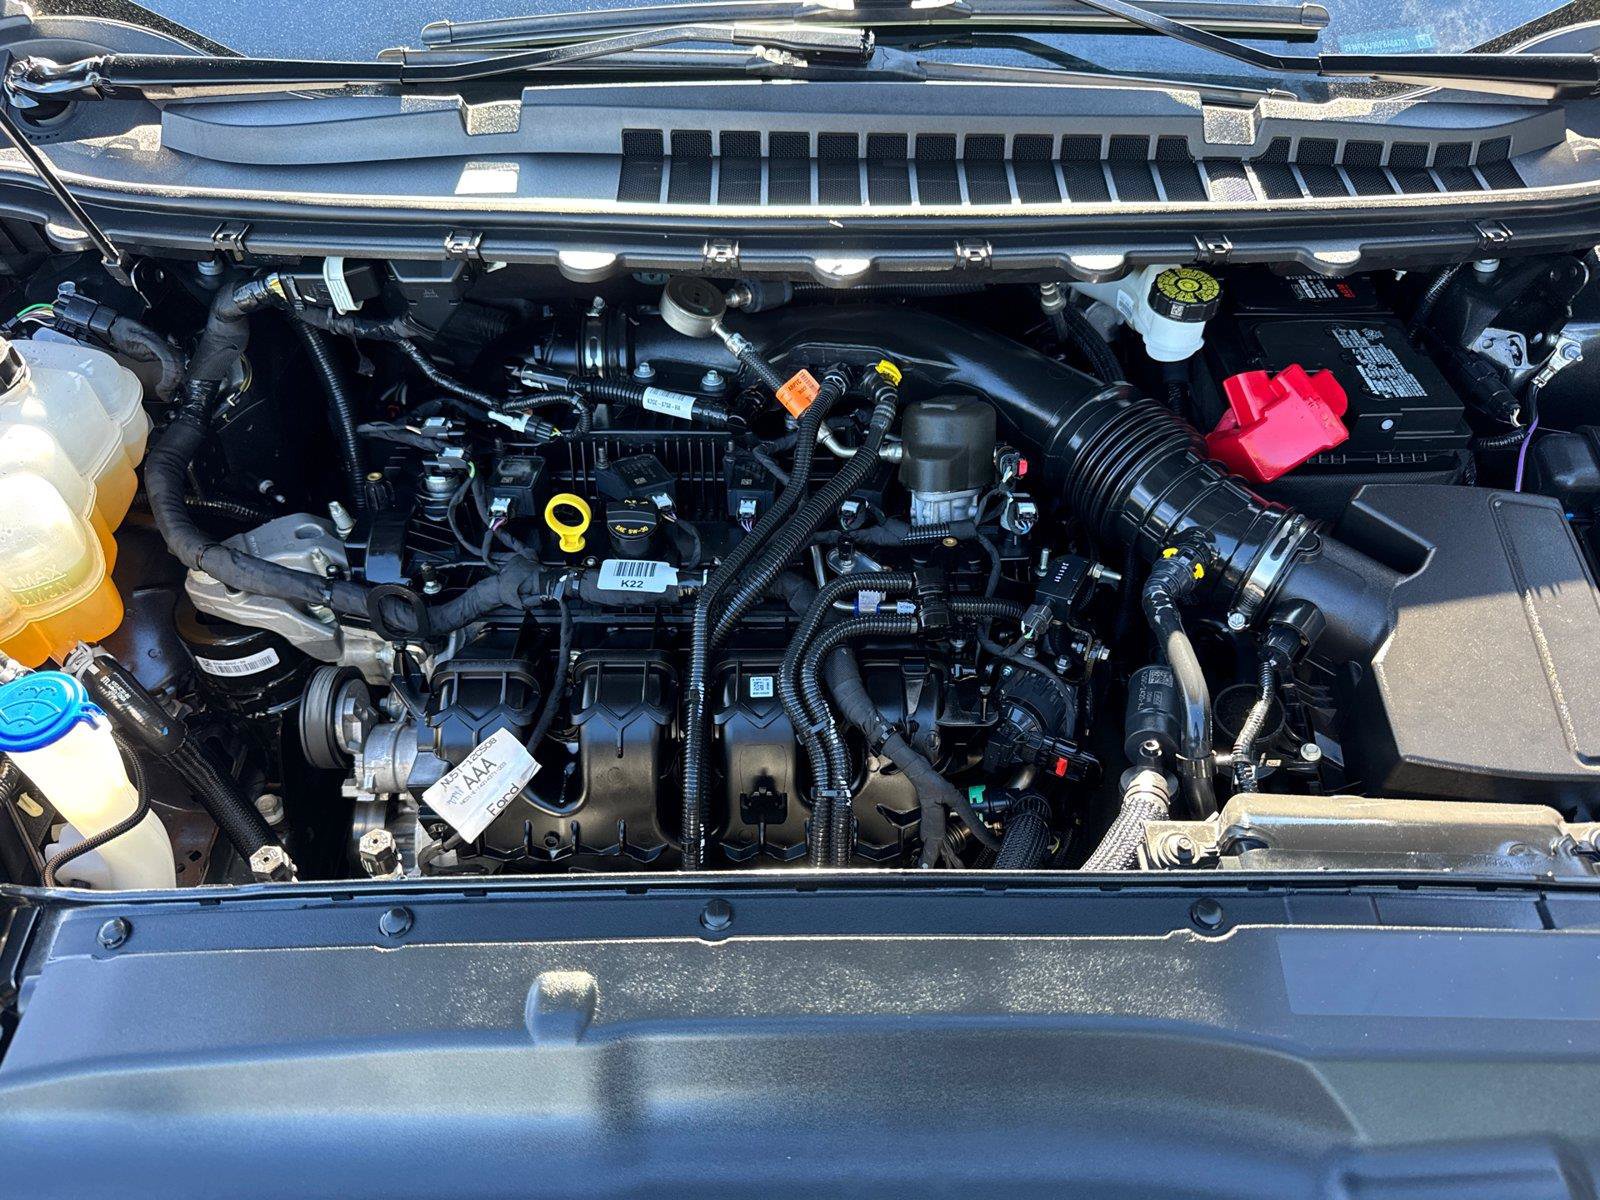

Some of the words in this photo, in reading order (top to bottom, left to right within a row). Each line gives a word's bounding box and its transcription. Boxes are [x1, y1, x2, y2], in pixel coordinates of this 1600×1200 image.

[620, 579, 644, 589] K22
[462, 757, 497, 790] AAA
[486, 782, 520, 816] Ford
